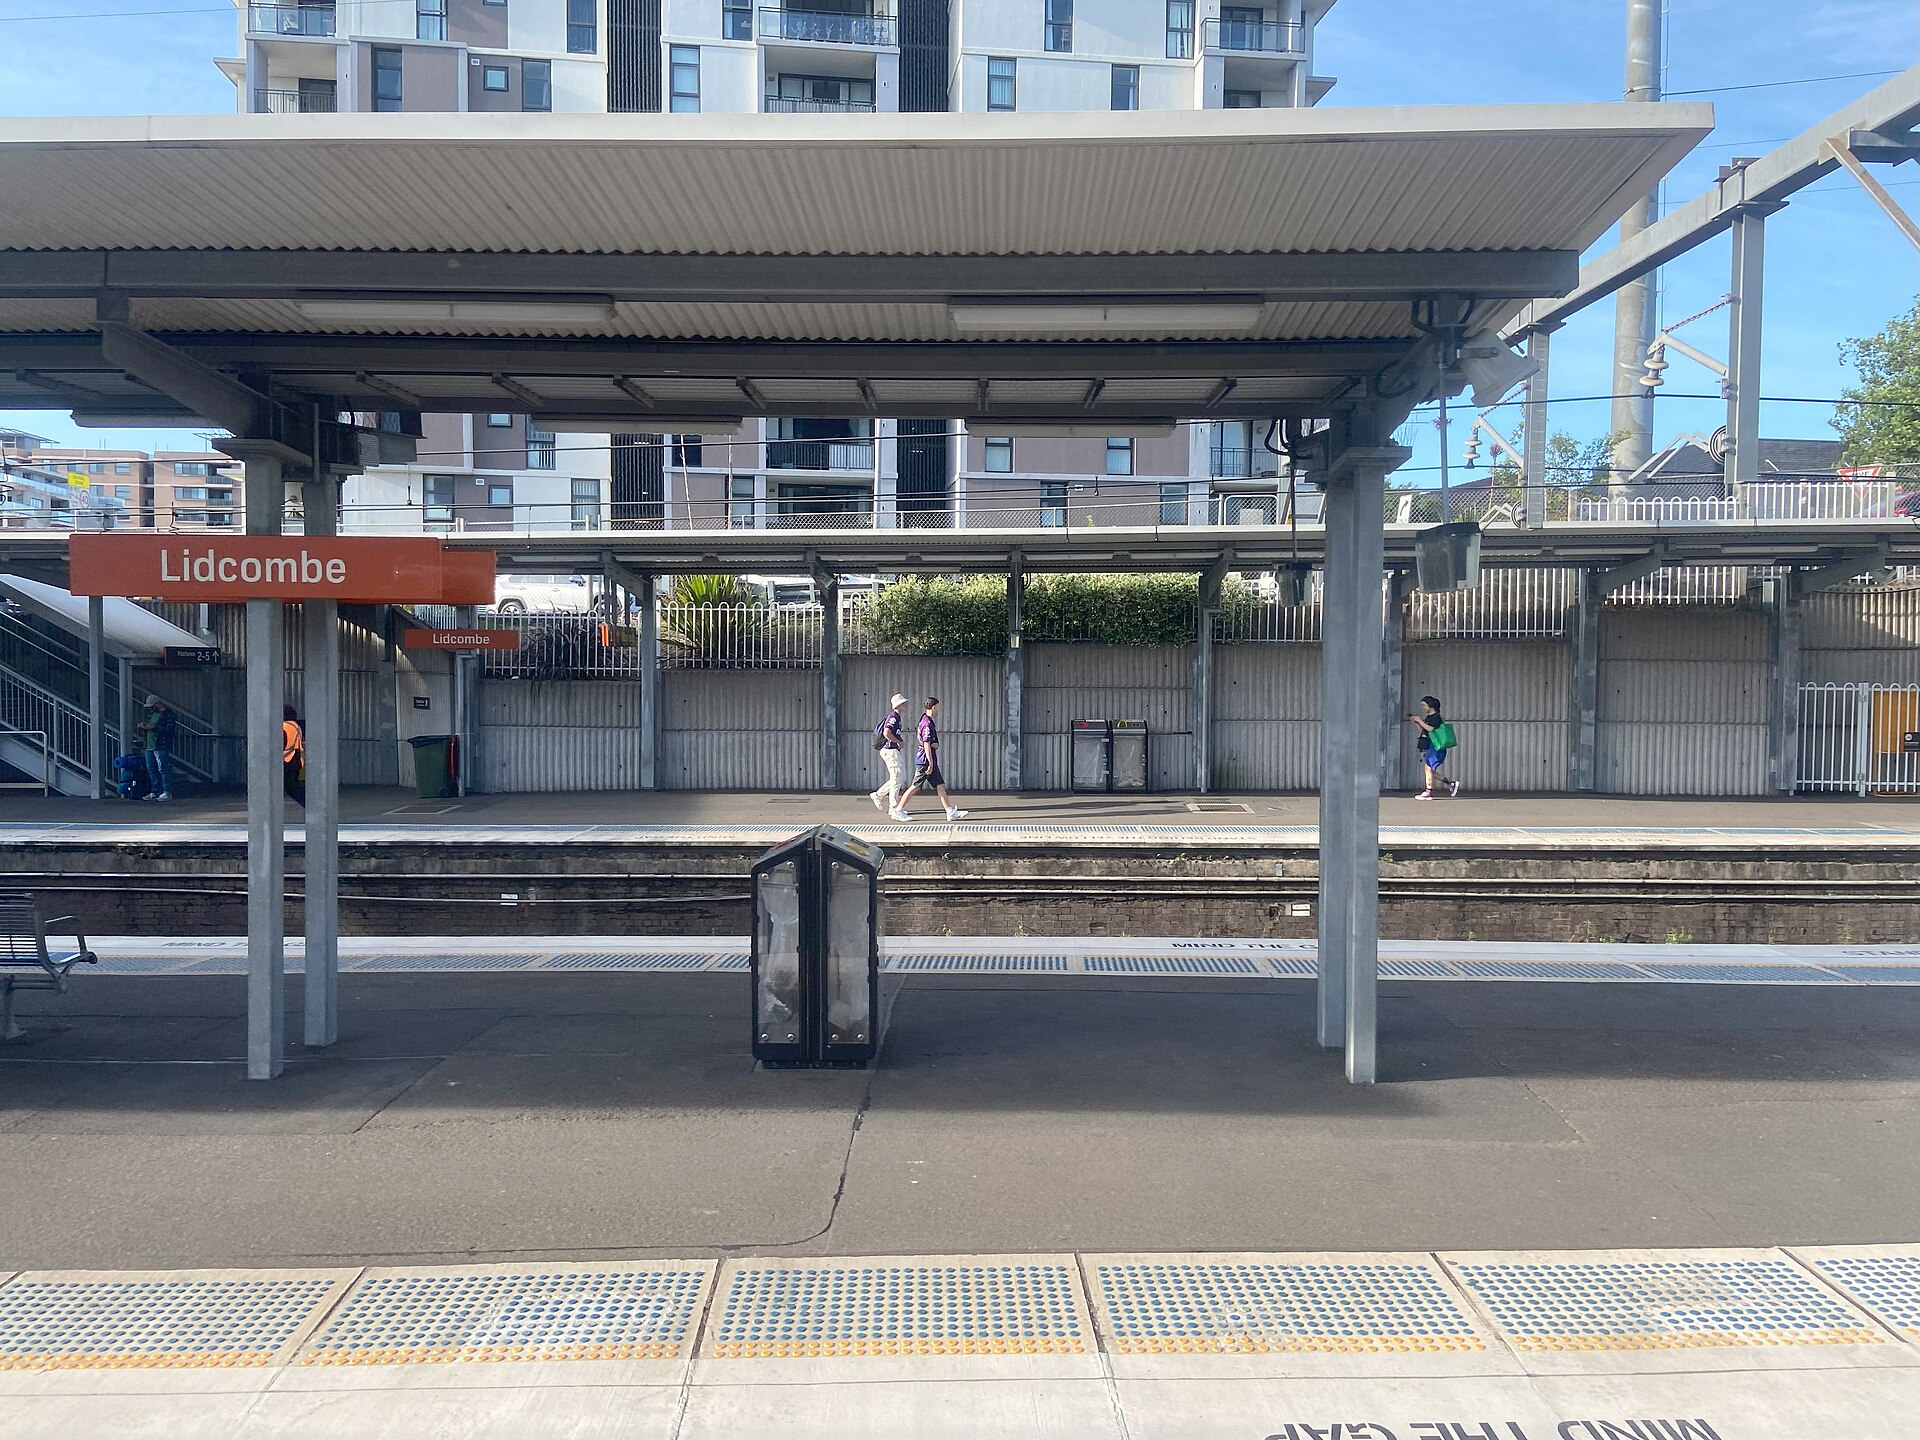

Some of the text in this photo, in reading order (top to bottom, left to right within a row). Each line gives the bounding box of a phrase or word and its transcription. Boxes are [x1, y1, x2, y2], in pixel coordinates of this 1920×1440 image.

[161, 549, 346, 584] Lidcombe
[432, 633, 490, 645] Lidcombe
[197, 651, 210, 662] 2-5
[1409, 1421, 1529, 1440] THE
[1557, 1419, 1723, 1440] MIND
